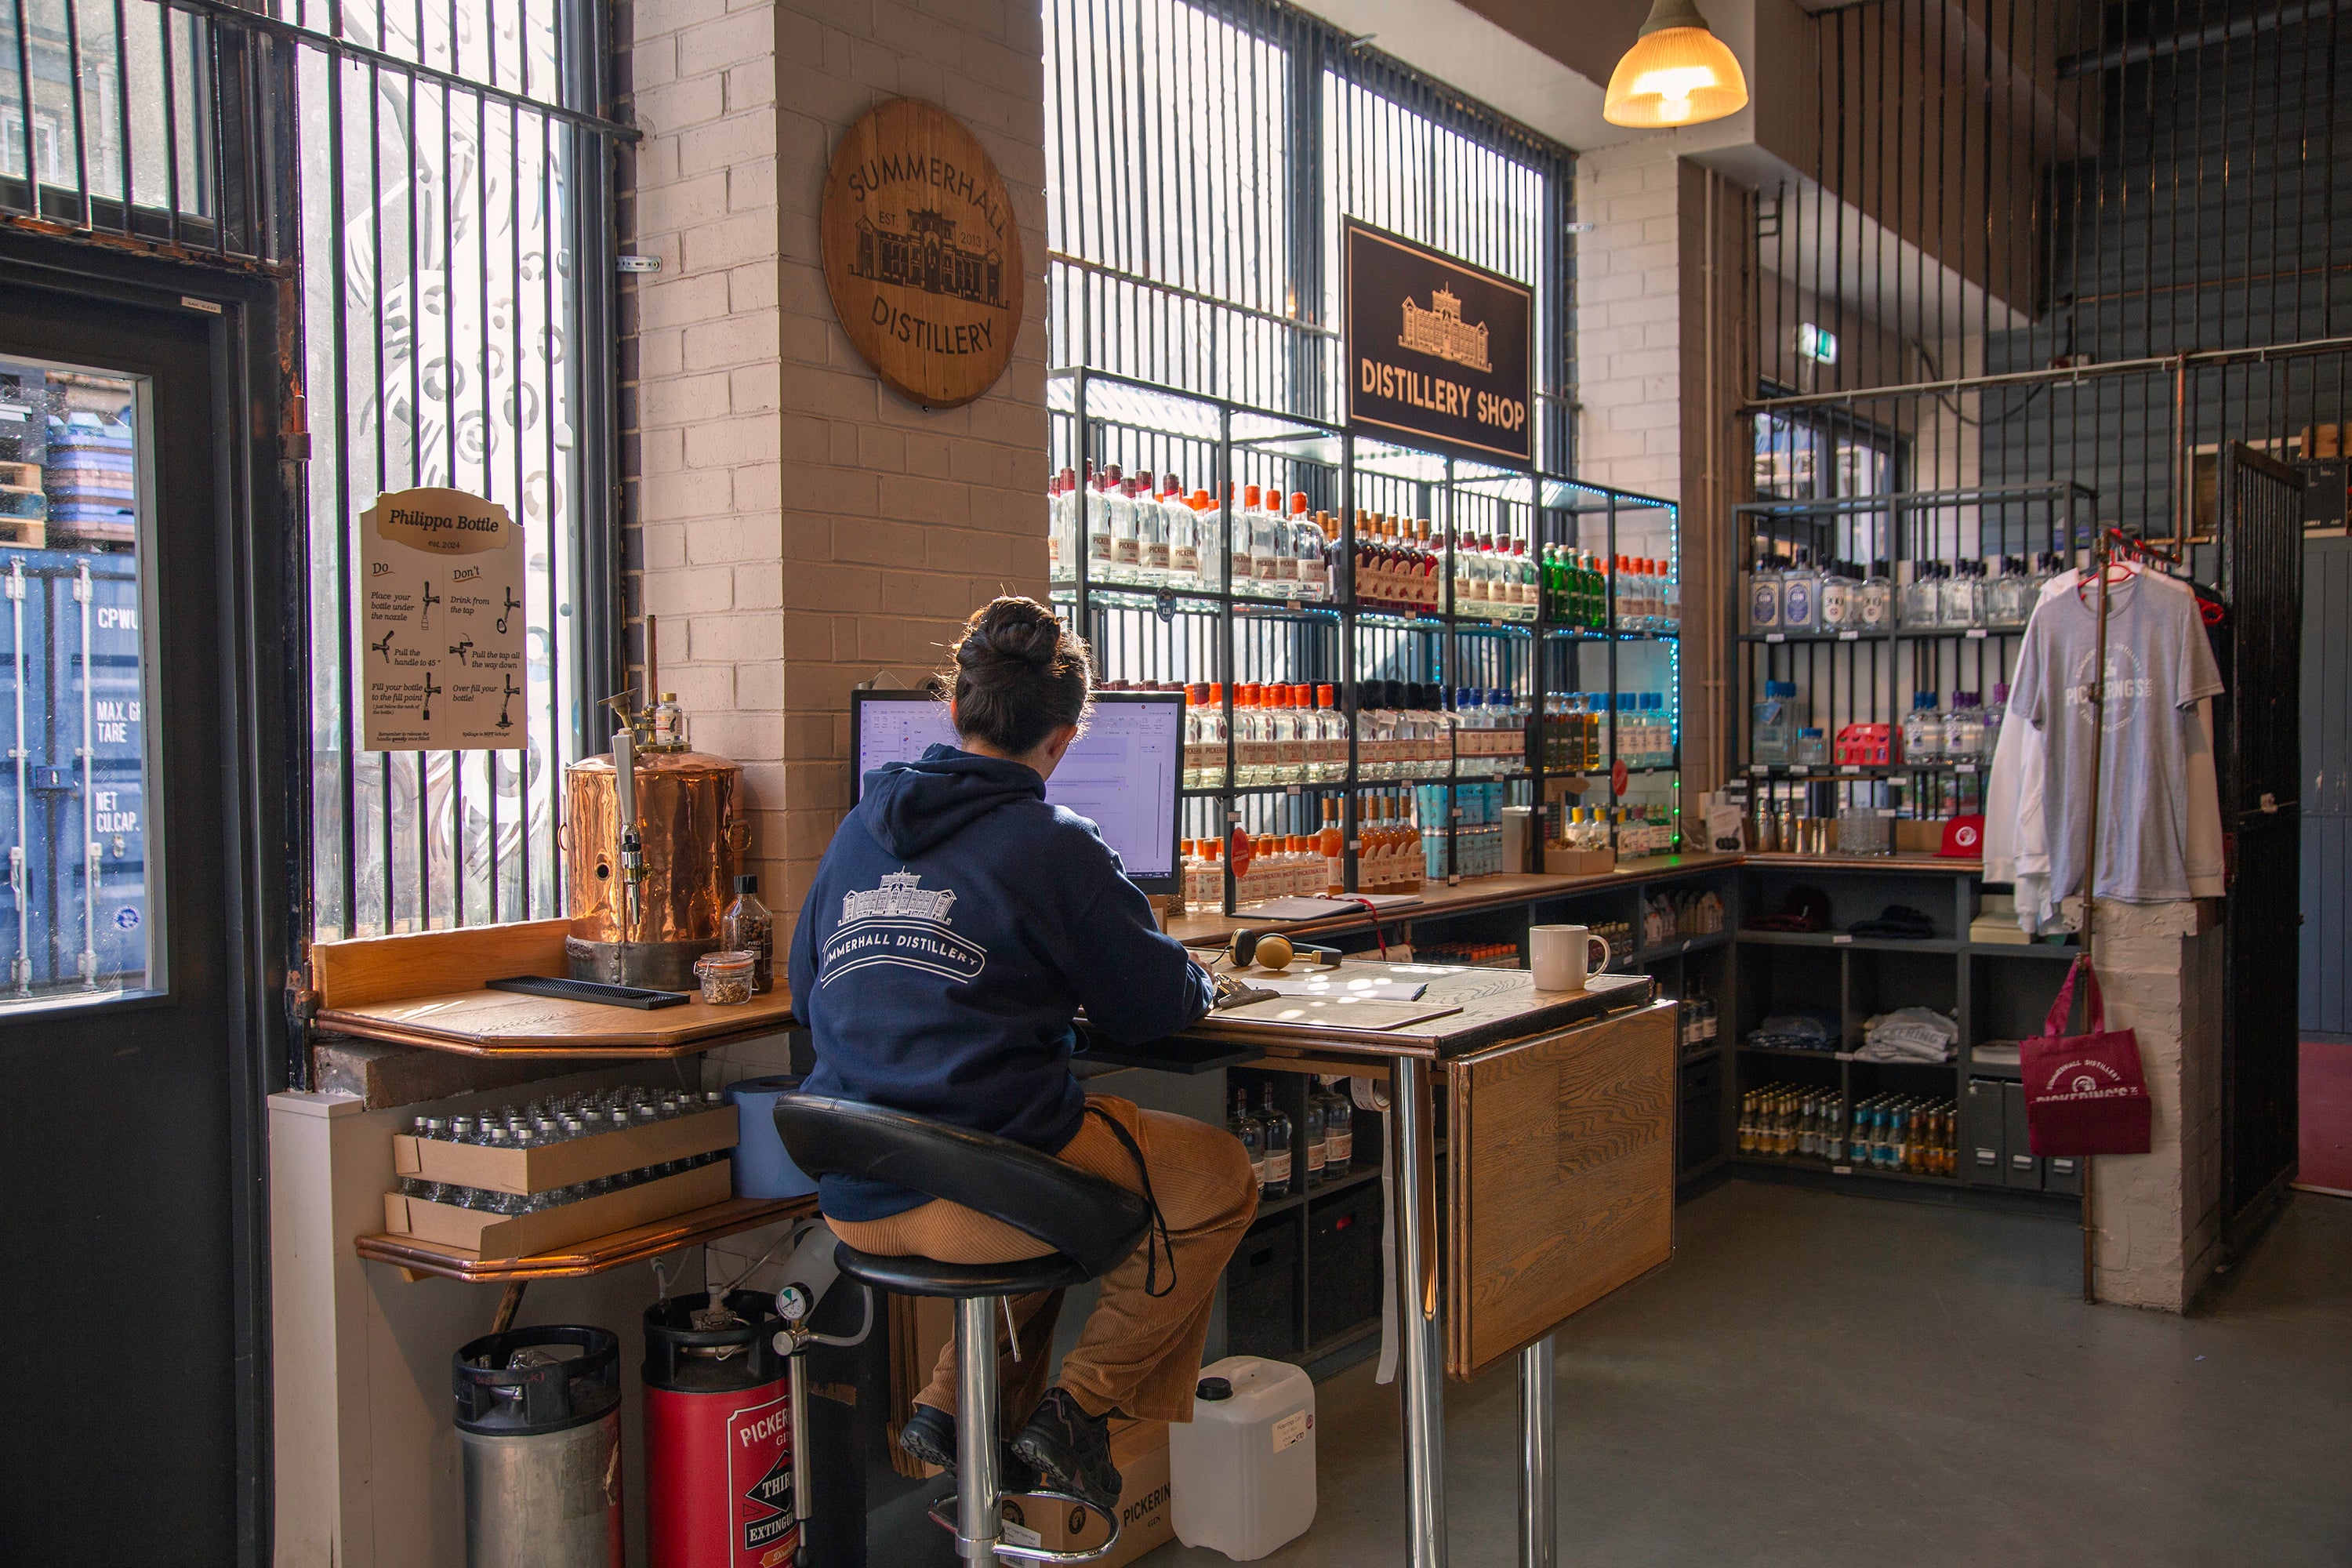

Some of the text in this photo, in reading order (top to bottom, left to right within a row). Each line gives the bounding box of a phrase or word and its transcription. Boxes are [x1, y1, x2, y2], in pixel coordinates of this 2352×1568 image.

[848, 151, 1009, 241] SUMMERHALL
[879, 210, 982, 249] EST. 2013
[870, 294, 994, 356] DISTILLERY
[1361, 358, 1525, 431] DISTILLERY SHOP
[389, 510, 499, 532] Philippa Bottle
[428, 539, 460, 550] est. 2024
[372, 562, 389, 574] Do
[453, 566, 480, 580] Don't
[371, 591, 391, 600] Place
[472, 597, 489, 606] from
[463, 607, 474, 615] tap
[392, 693, 402, 702] fill
[404, 694, 423, 702] point
[470, 684, 481, 694] fill
[96, 701, 127, 722] MAX.
[97, 722, 127, 743] TARE
[96, 791, 118, 812] NET
[824, 933, 978, 967] UMMERHALL DISTILLERY
[2084, 1059, 2122, 1082] DISTILLERY
[1123, 1481, 1171, 1527] PICKERIN
[1148, 1514, 1160, 1528] GIN
